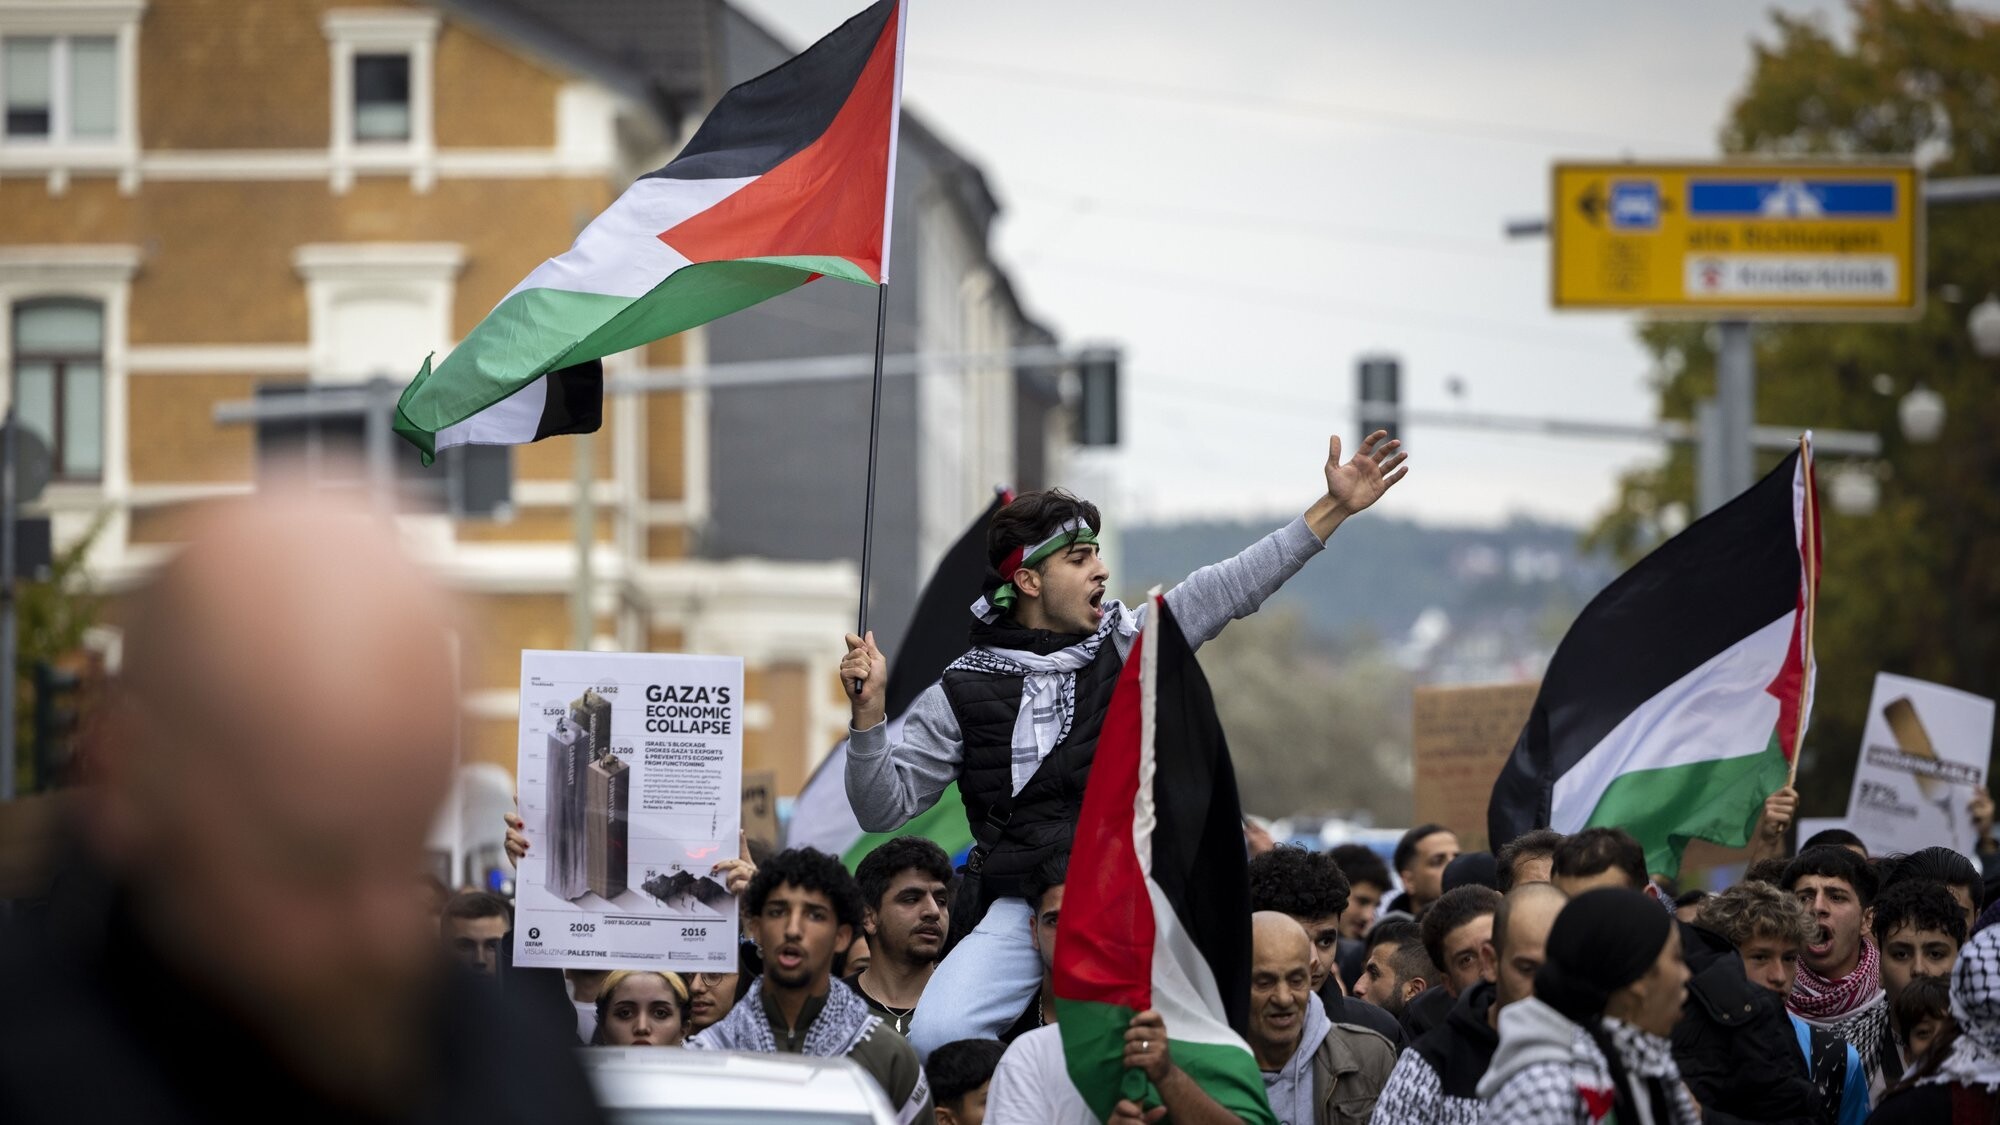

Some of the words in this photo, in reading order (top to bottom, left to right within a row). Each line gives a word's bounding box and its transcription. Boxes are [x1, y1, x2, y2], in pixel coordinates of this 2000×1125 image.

[596, 686, 619, 694] 1,802
[645, 684, 731, 704] GAZA'S
[543, 708, 566, 716] 1,500
[646, 705, 731, 719] ECONOMIC
[645, 719, 731, 735] COLLAPSE
[569, 923, 596, 932] 2005
[681, 928, 707, 936] 2016
